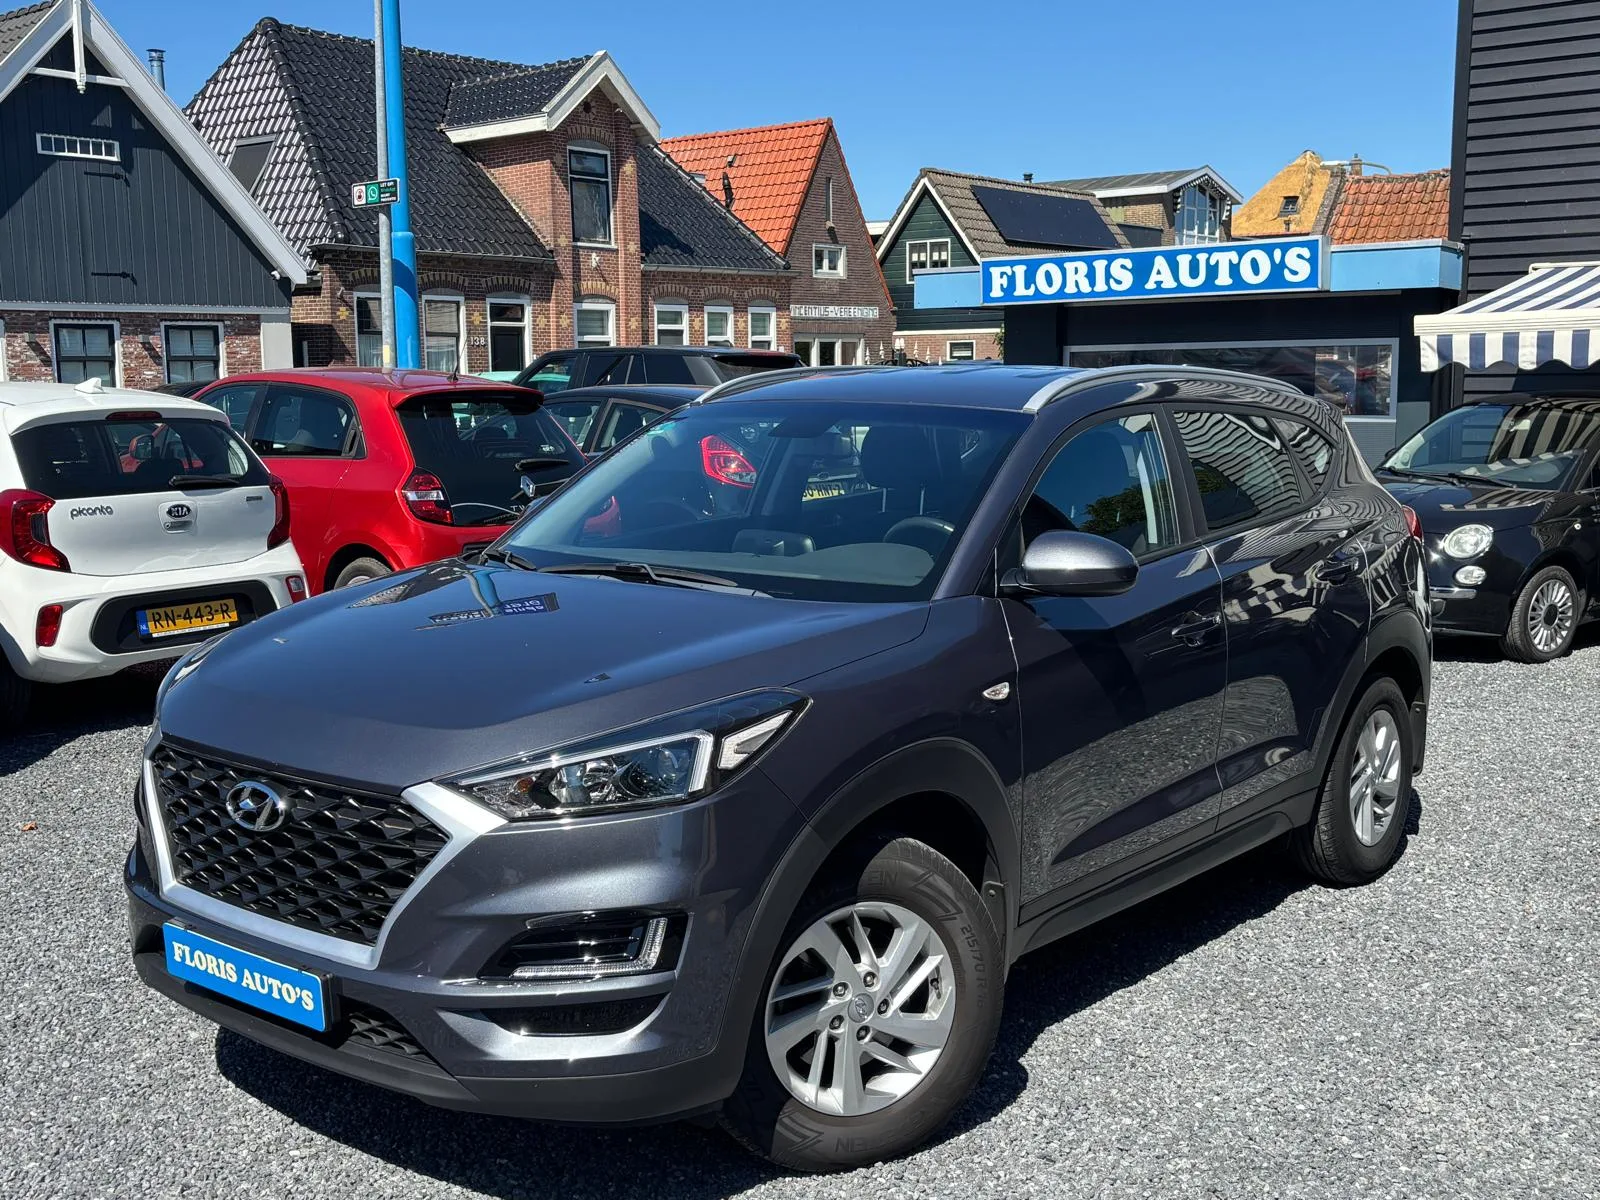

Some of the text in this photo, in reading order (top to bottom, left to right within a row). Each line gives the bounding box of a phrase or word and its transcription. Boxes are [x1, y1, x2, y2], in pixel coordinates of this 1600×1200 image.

[988, 246, 1311, 297] FLORIS AUTO'S
[470, 336, 486, 345] 138
[70, 505, 113, 520] picanto
[170, 505, 190, 517] KIA
[151, 602, 231, 629] RN-443-R
[172, 941, 314, 1011] FLORIS AUTO'S
